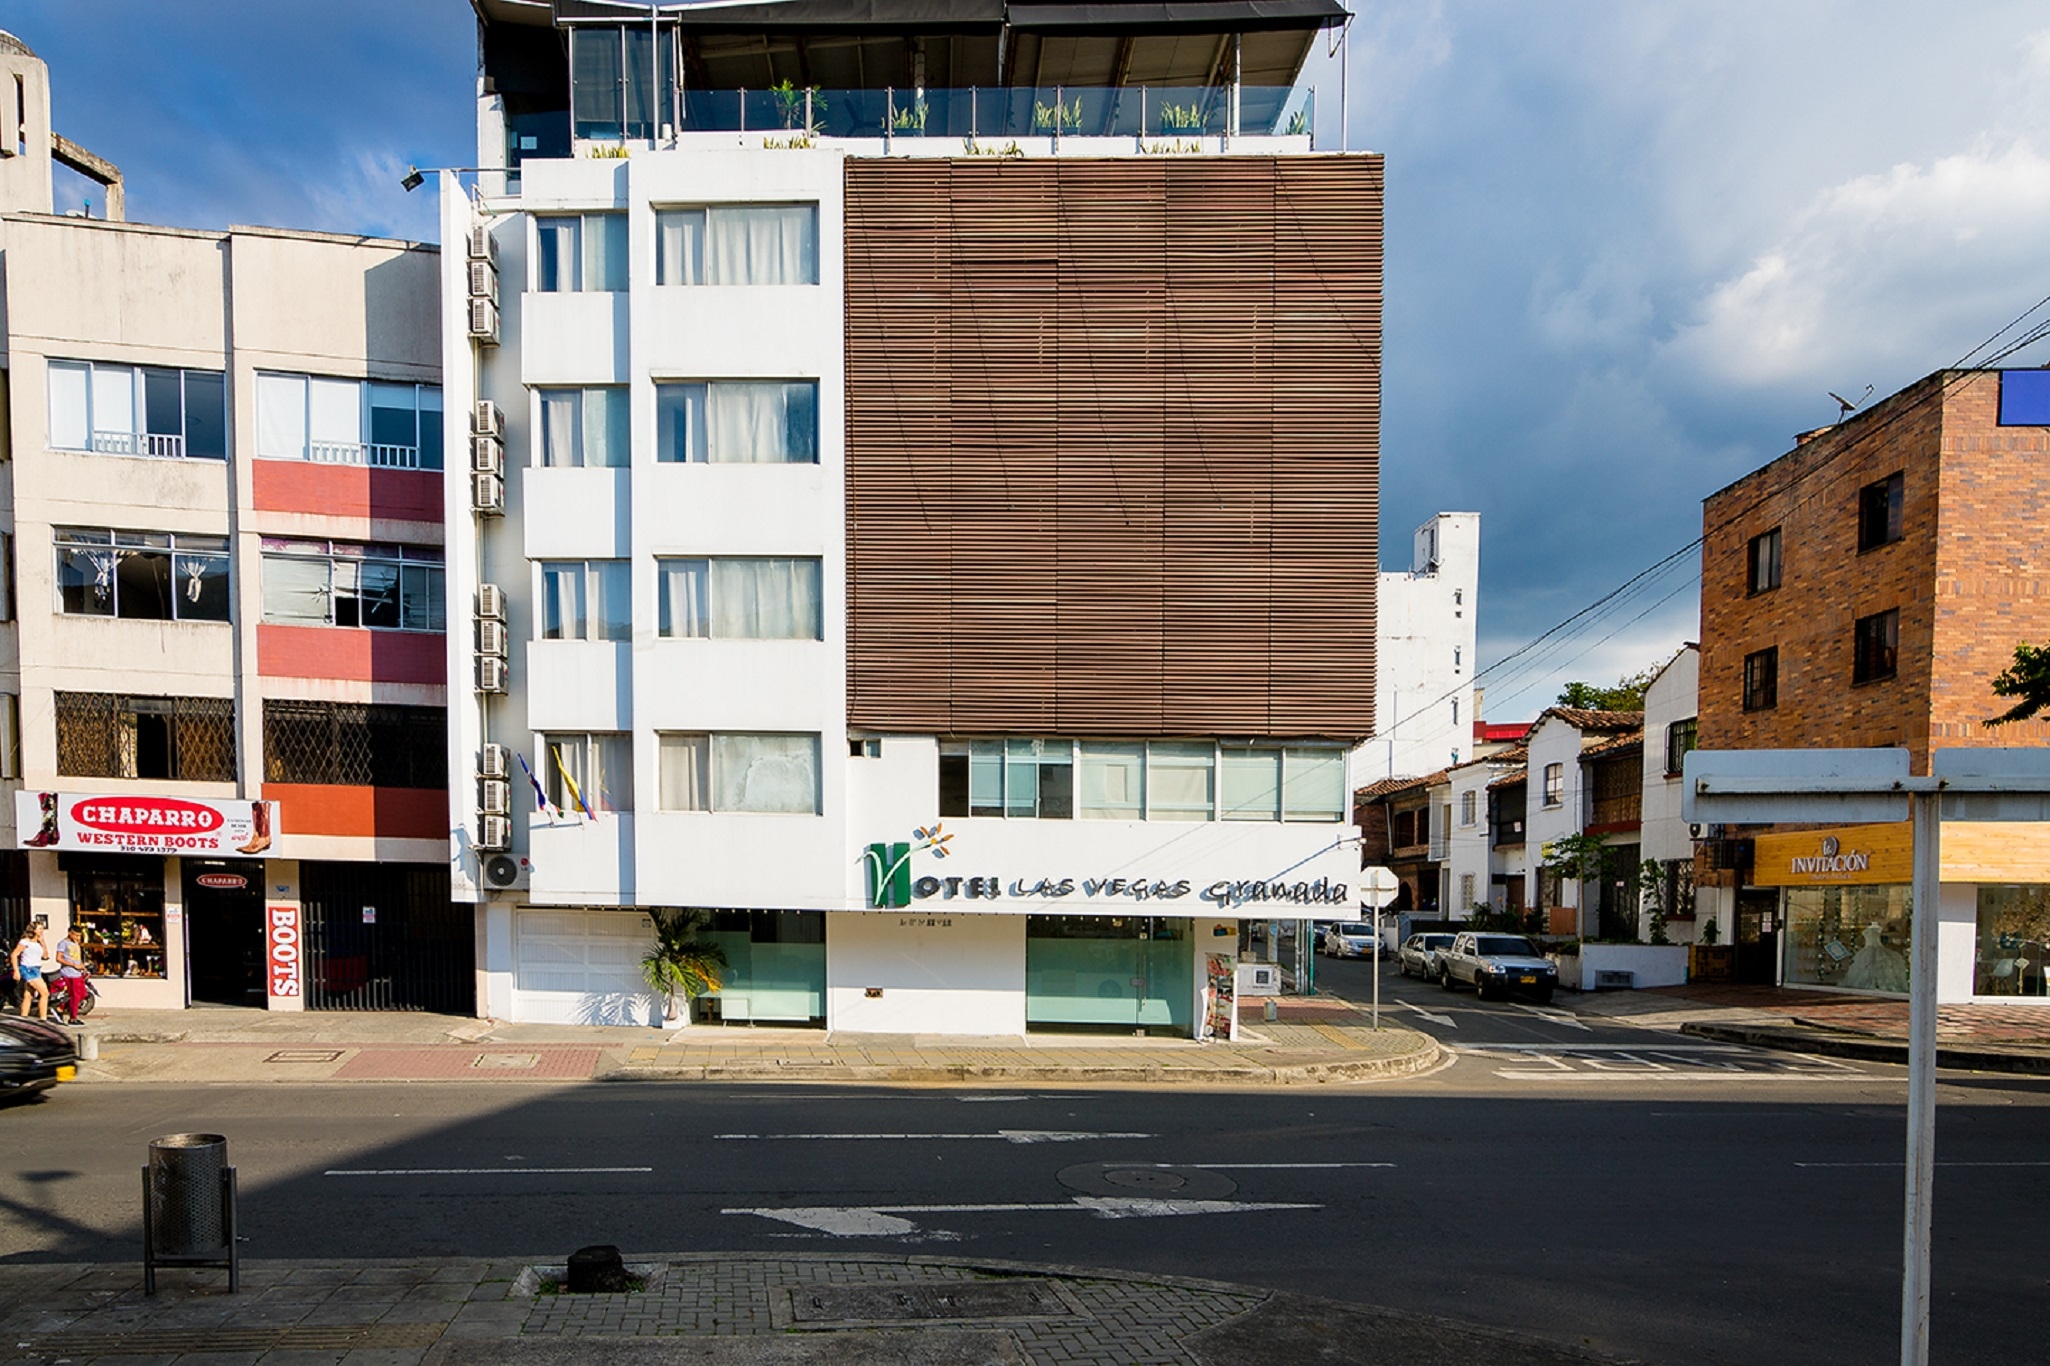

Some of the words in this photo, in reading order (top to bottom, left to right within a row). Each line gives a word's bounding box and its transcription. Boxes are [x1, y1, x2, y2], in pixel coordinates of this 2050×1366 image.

[83, 805, 213, 828] CHAPARRO
[77, 832, 160, 846] WESTERN
[164, 836, 219, 849] BOOTS
[1791, 848, 1869, 874] INVITACIÓN
[1013, 877, 1076, 895] LAS
[1086, 877, 1191, 900] VEGAS
[1205, 876, 1349, 905] Granada
[271, 908, 300, 997] BOOTS
